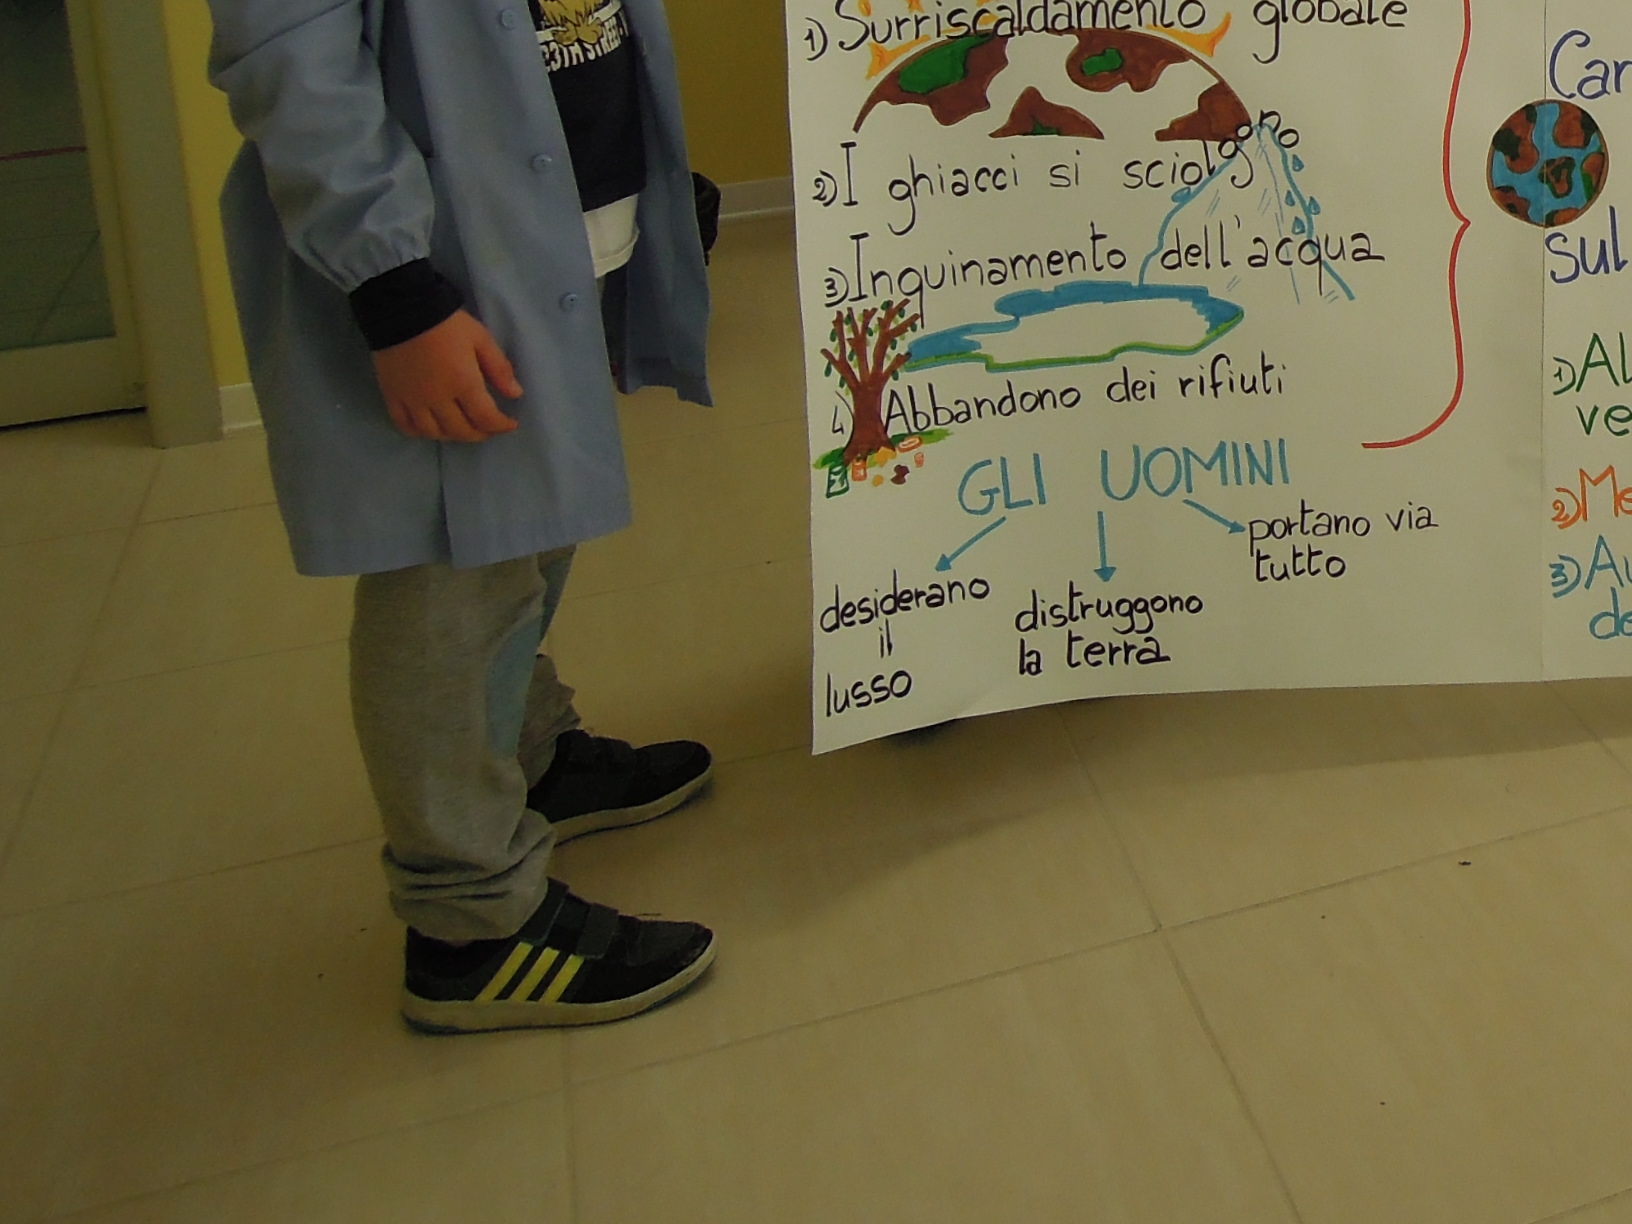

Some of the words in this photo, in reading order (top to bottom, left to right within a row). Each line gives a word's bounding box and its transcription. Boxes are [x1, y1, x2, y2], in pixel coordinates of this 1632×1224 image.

[887, 150, 1020, 236] ghiacci
[1049, 150, 1081, 187] si
[885, 381, 1082, 435] Abbandono
[1106, 367, 1157, 403] dei
[1178, 350, 1285, 398] rifiuti
[958, 453, 1048, 516] GLI
[1101, 438, 1291, 502] UOMINI
[1247, 500, 1371, 556] portano
[1385, 502, 1440, 534] via
[1254, 547, 1347, 583] tutto
[819, 568, 991, 633] desiderano
[1014, 581, 1204, 638] distruggono
[878, 620, 894, 659] il
[1018, 637, 1043, 676] la
[1065, 632, 1172, 671] terra
[826, 668, 913, 718] lusso
